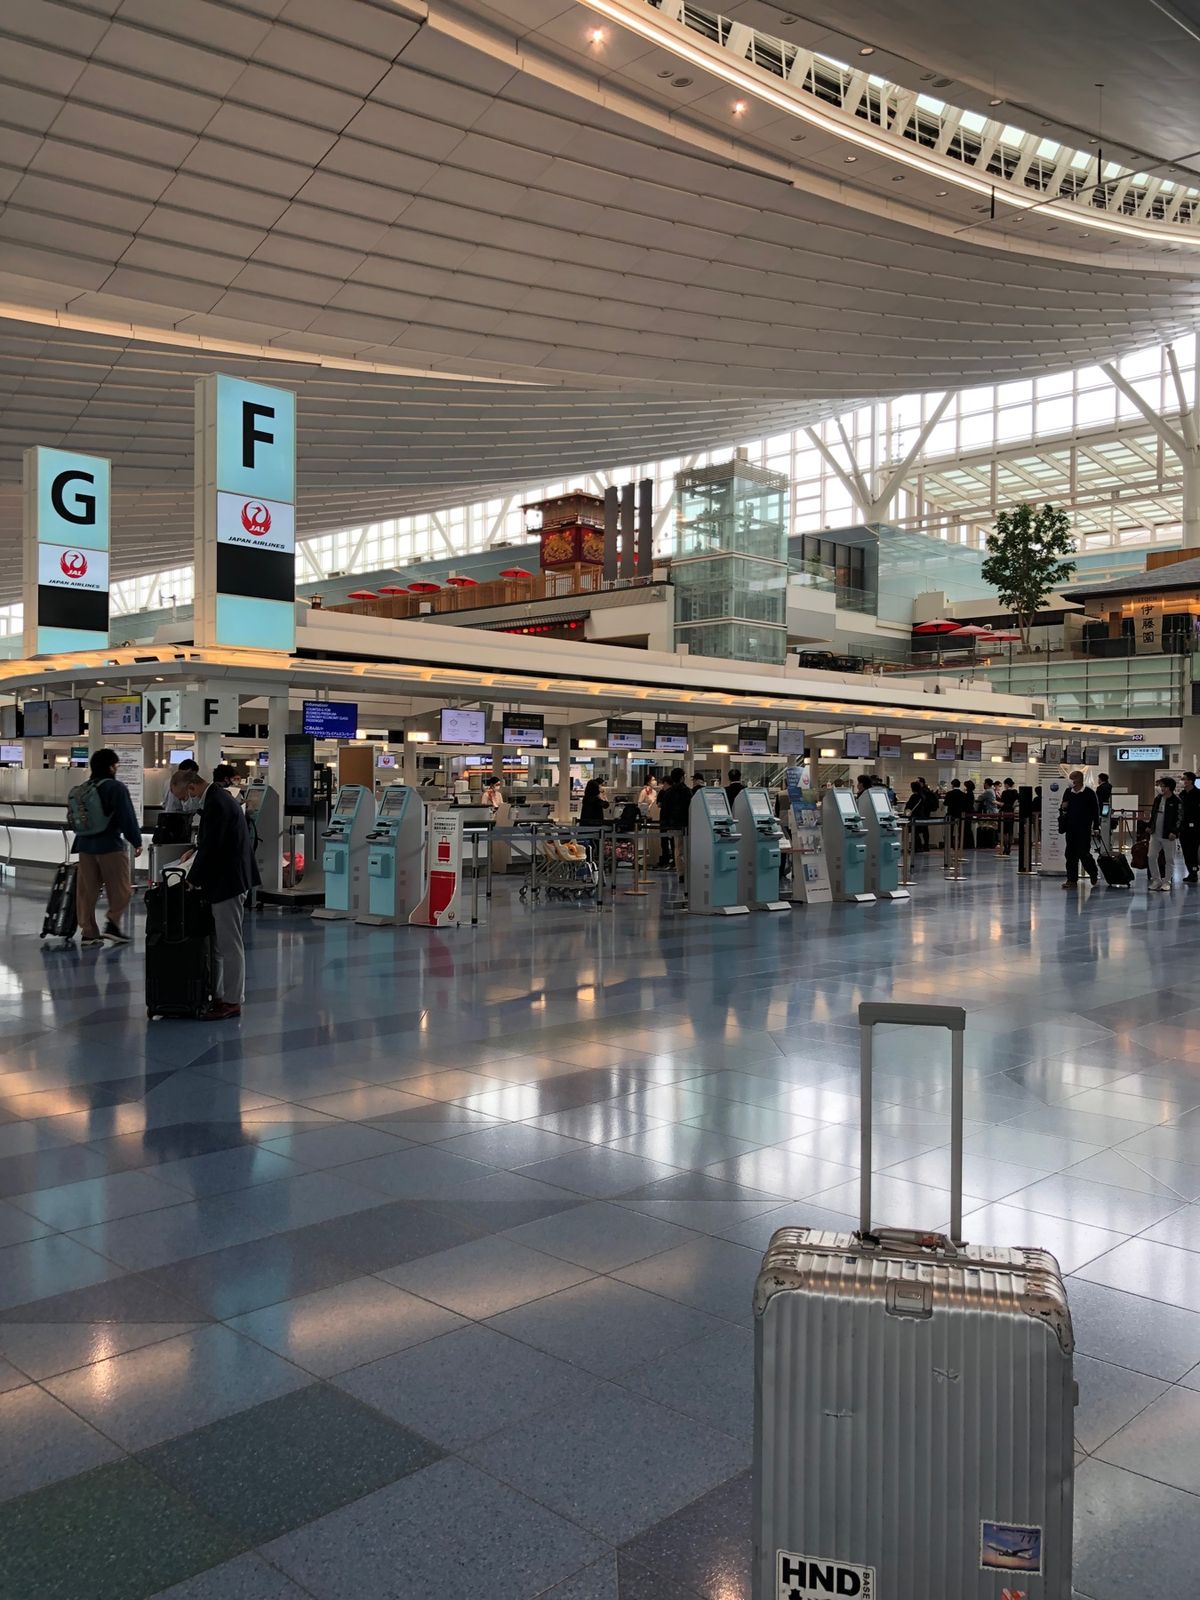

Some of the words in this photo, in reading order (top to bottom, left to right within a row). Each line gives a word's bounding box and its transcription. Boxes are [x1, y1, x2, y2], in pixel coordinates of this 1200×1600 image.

[242, 400, 275, 469] F
[51, 470, 96, 525] G
[228, 536, 251, 544] JAPAN
[252, 540, 286, 550] AIRLINES
[249, 525, 266, 533] JAL
[1140, 604, 1155, 643] 伊藤園
[160, 697, 172, 725] F
[204, 698, 219, 725] F
[782, 1557, 861, 1597] HND
[862, 1572, 871, 1600] BASE
